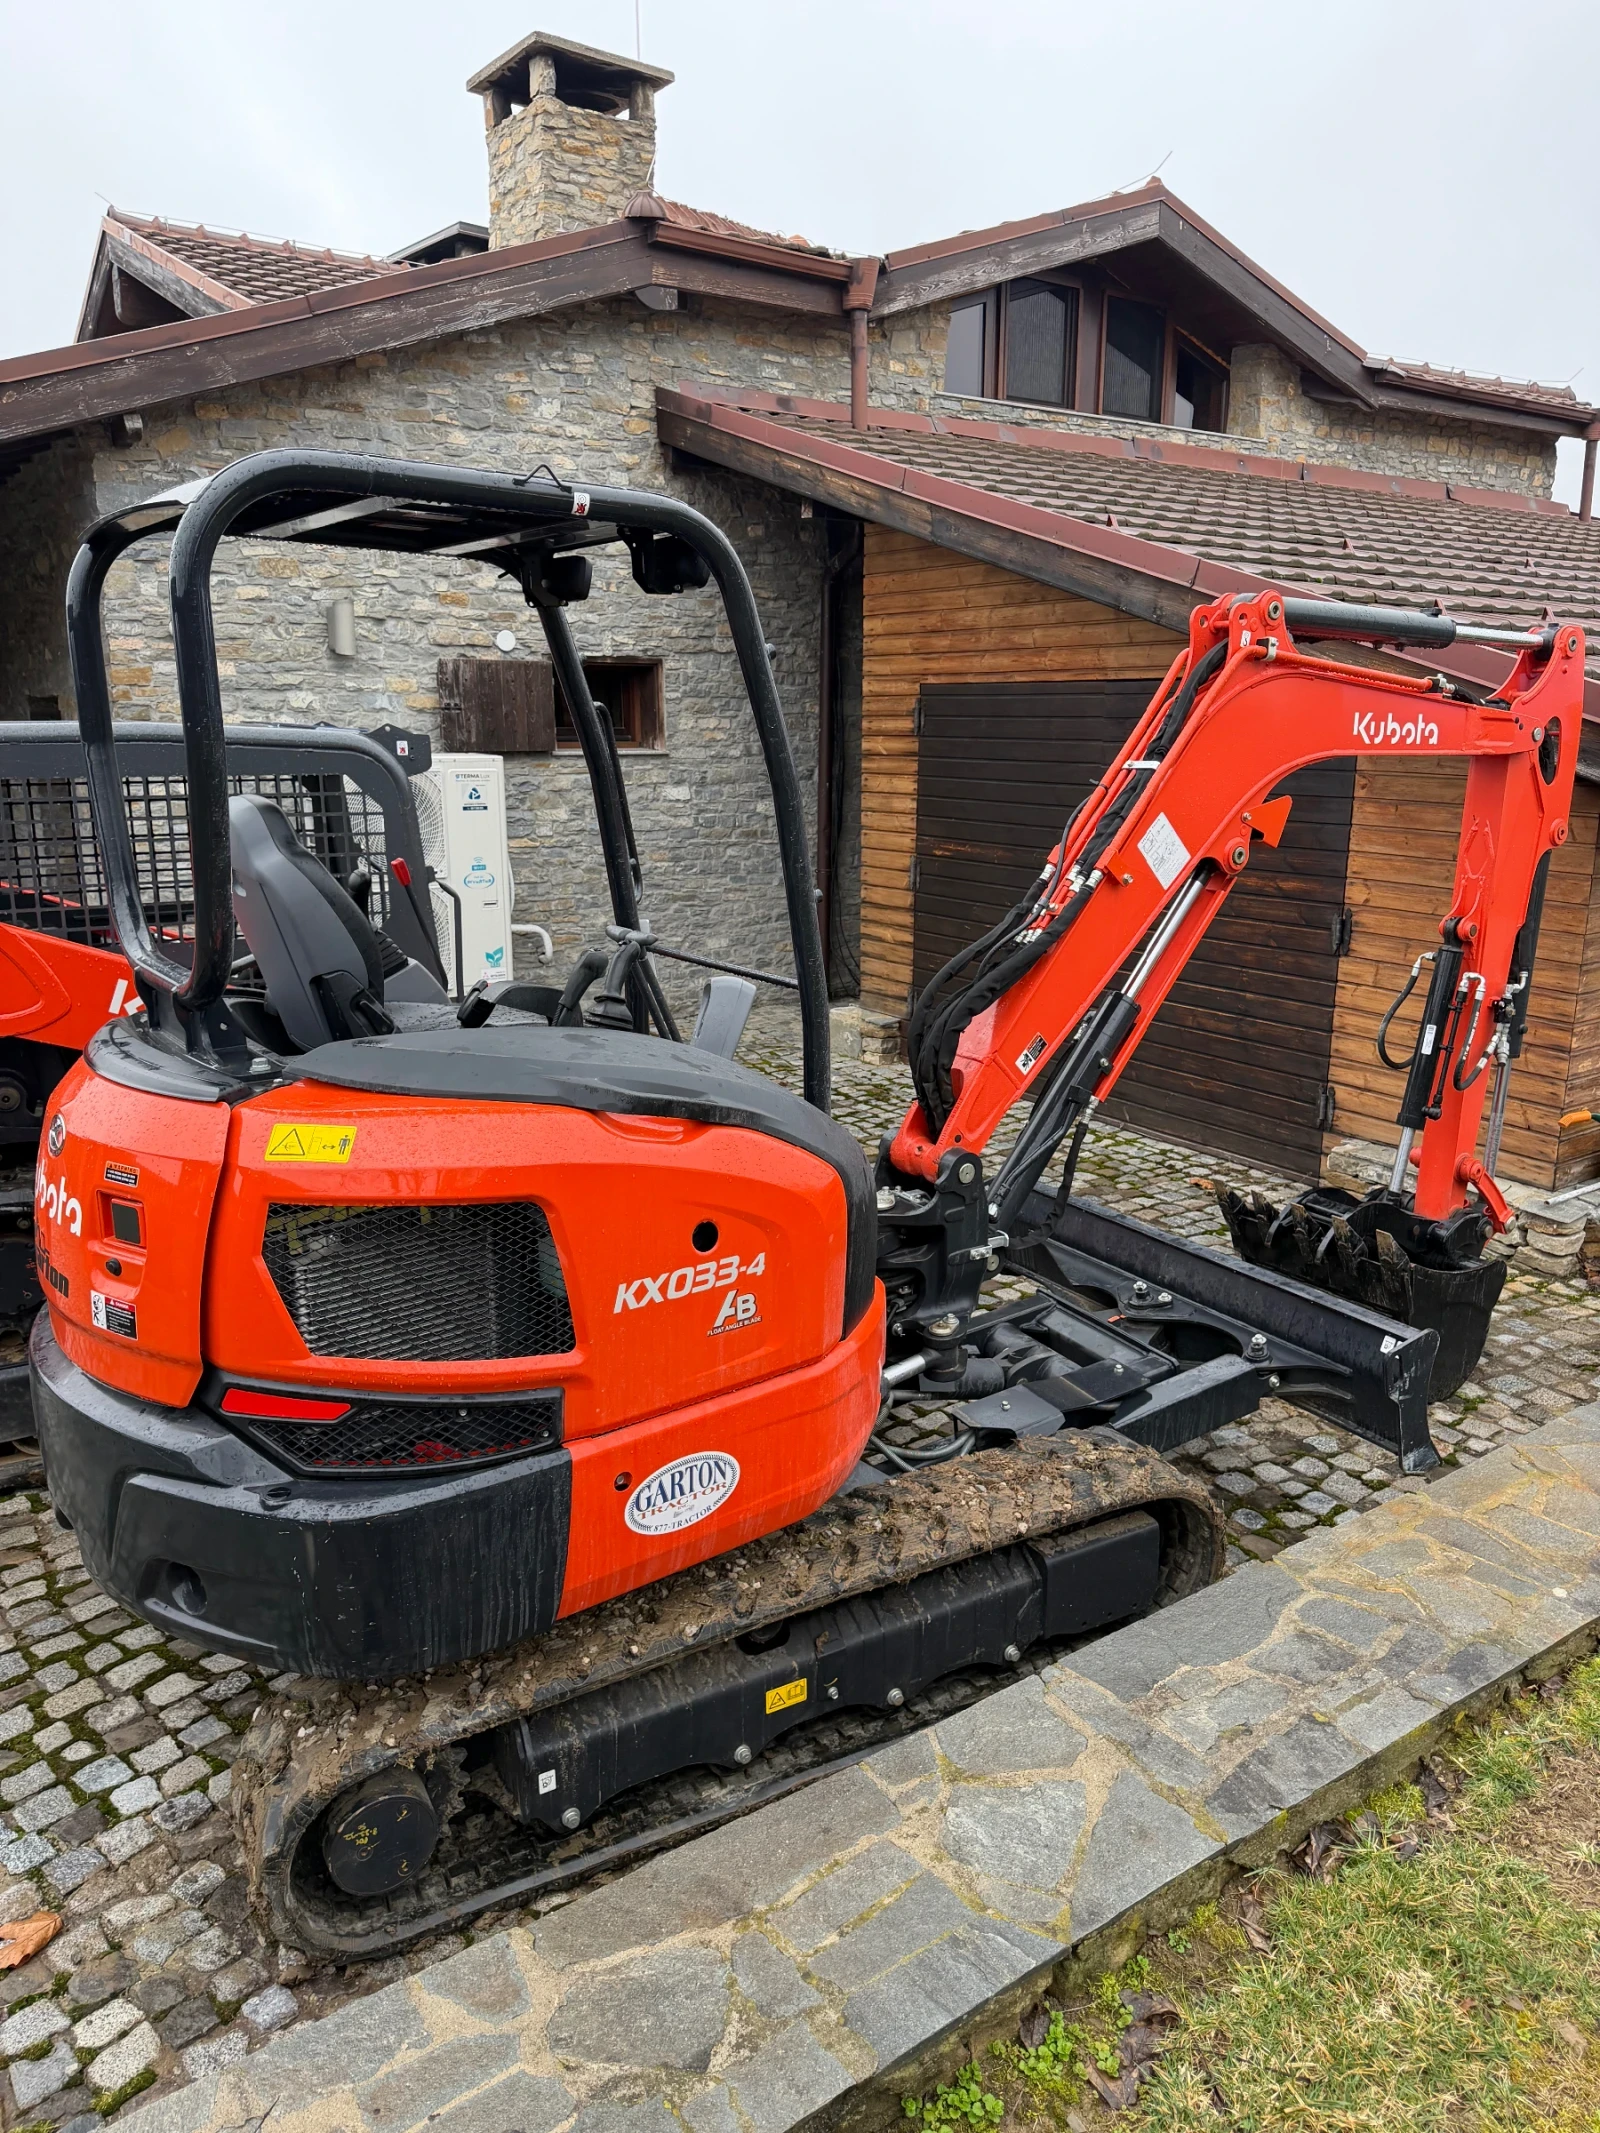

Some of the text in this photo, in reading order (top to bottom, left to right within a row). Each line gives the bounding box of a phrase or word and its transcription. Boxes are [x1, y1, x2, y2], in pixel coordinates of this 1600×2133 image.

[1352, 711, 1439, 745] Kubota
[613, 1252, 766, 1314] KX033-4
[707, 1315, 762, 1337] FLOAT ANGLE BLADE
[635, 1460, 728, 1512] GARTON
[637, 1481, 728, 1520] TRACTOR
[653, 1504, 714, 1533] 877-TRACTOR
